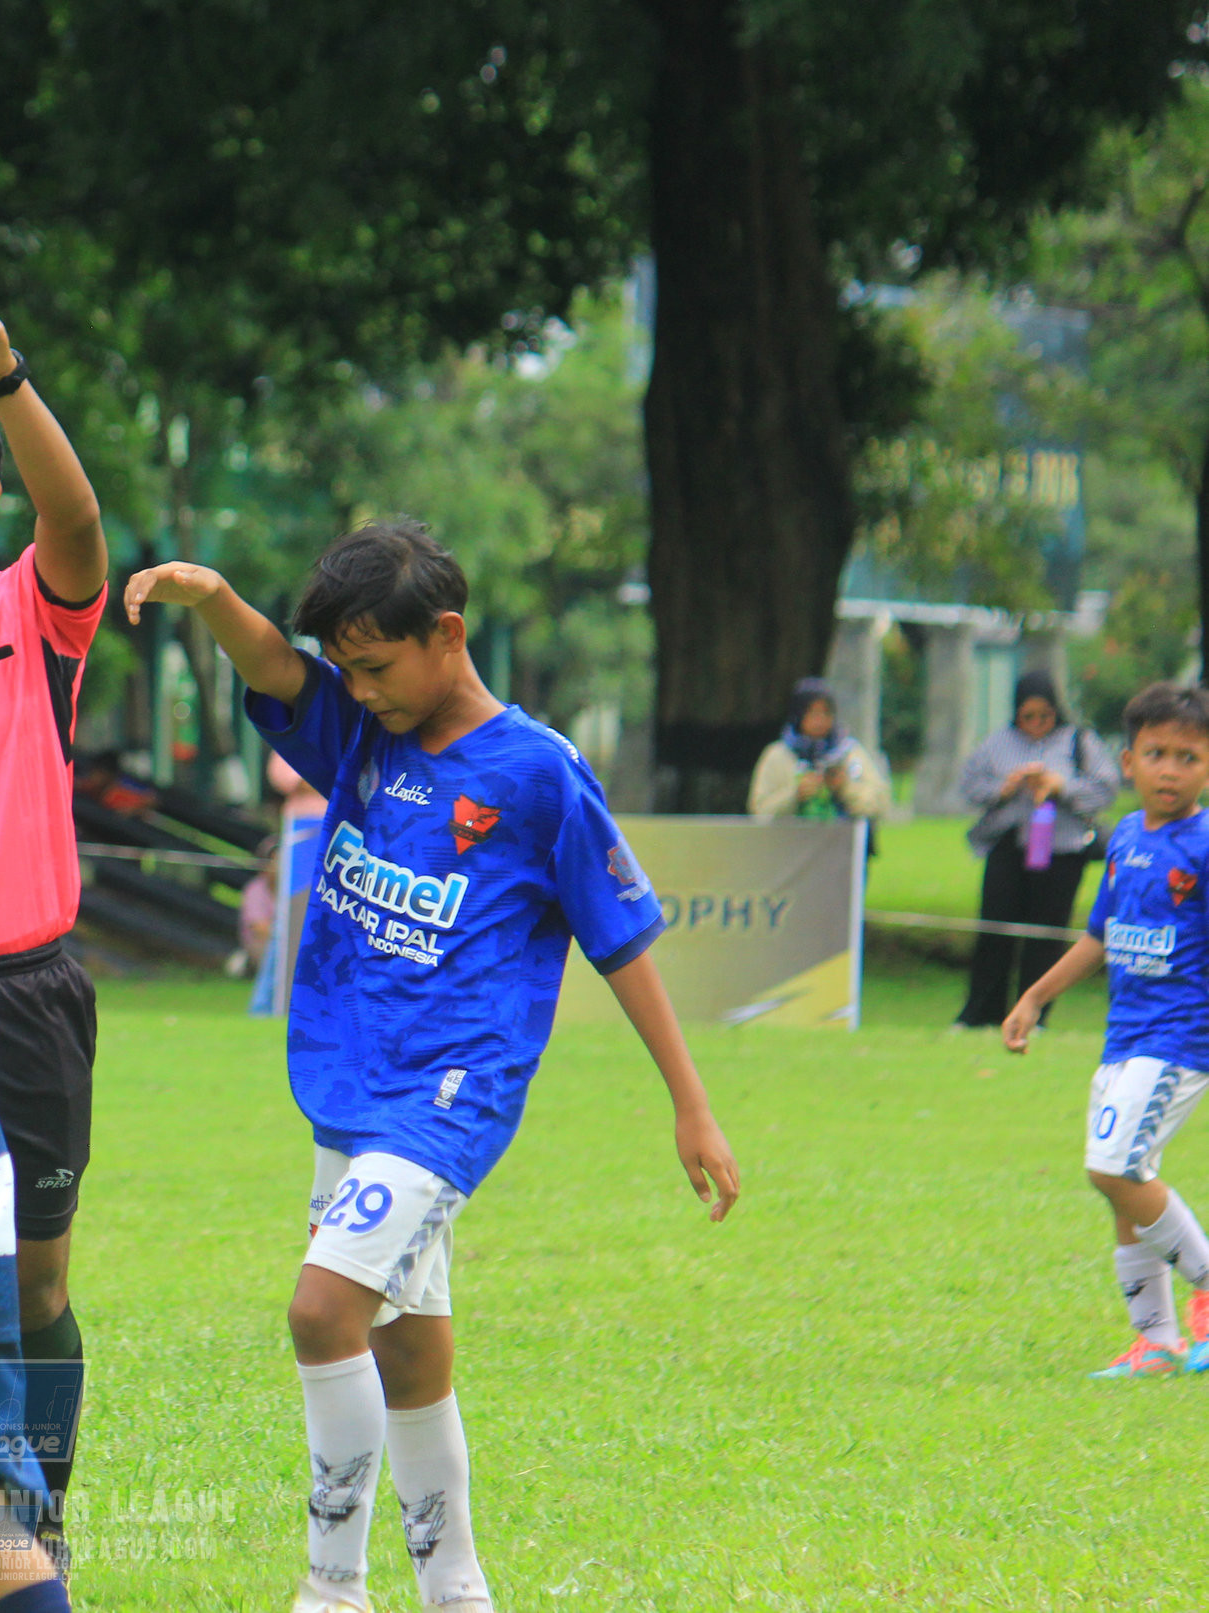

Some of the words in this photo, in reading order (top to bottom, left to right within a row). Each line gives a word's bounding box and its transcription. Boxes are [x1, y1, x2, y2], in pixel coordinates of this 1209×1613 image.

[324, 820, 469, 929] Farmel
[367, 934, 439, 968] INDONESIA
[384, 919, 445, 955] IPAL
[320, 1178, 392, 1234] 29
